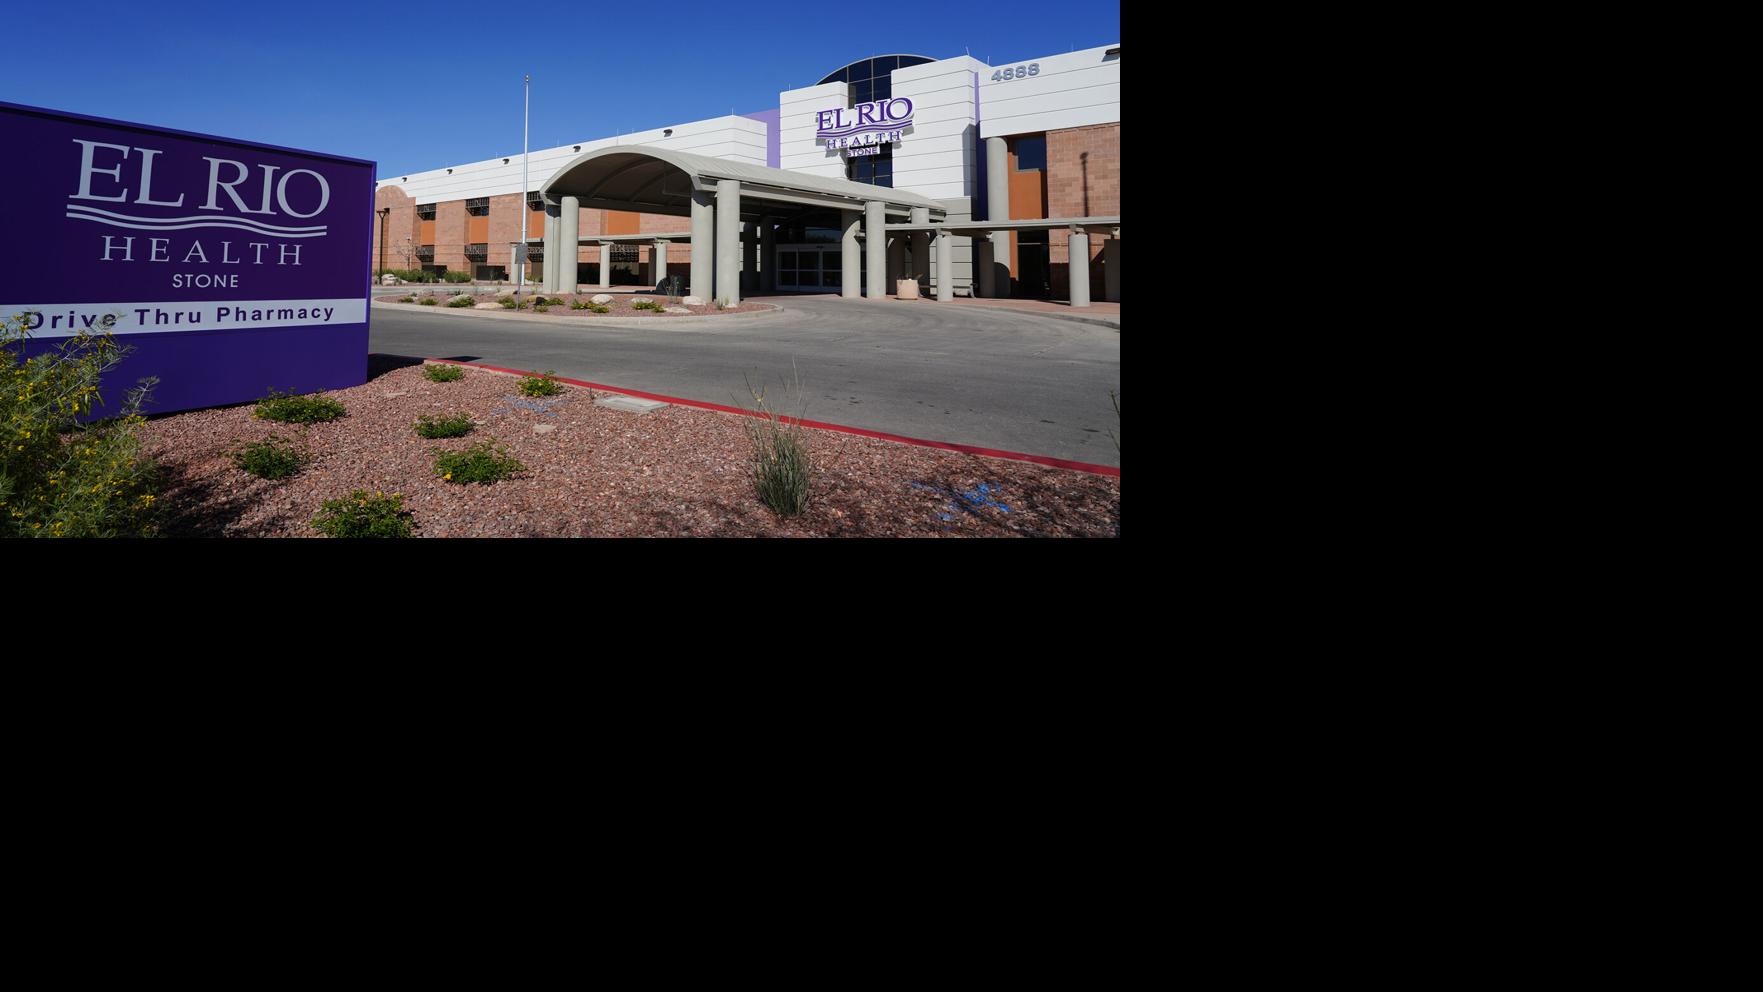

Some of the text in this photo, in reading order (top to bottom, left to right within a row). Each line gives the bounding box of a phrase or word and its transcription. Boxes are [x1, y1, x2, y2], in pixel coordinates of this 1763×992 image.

[990, 62, 1041, 82] 4888
[816, 97, 913, 131] EL RIO
[826, 130, 901, 149] HEALTH
[847, 147, 878, 157] STONE
[68, 138, 331, 219] EL RIO
[100, 235, 304, 266] HEALTH
[172, 273, 240, 289] STONE
[22, 306, 335, 330] Drive Thru Pharmacy
